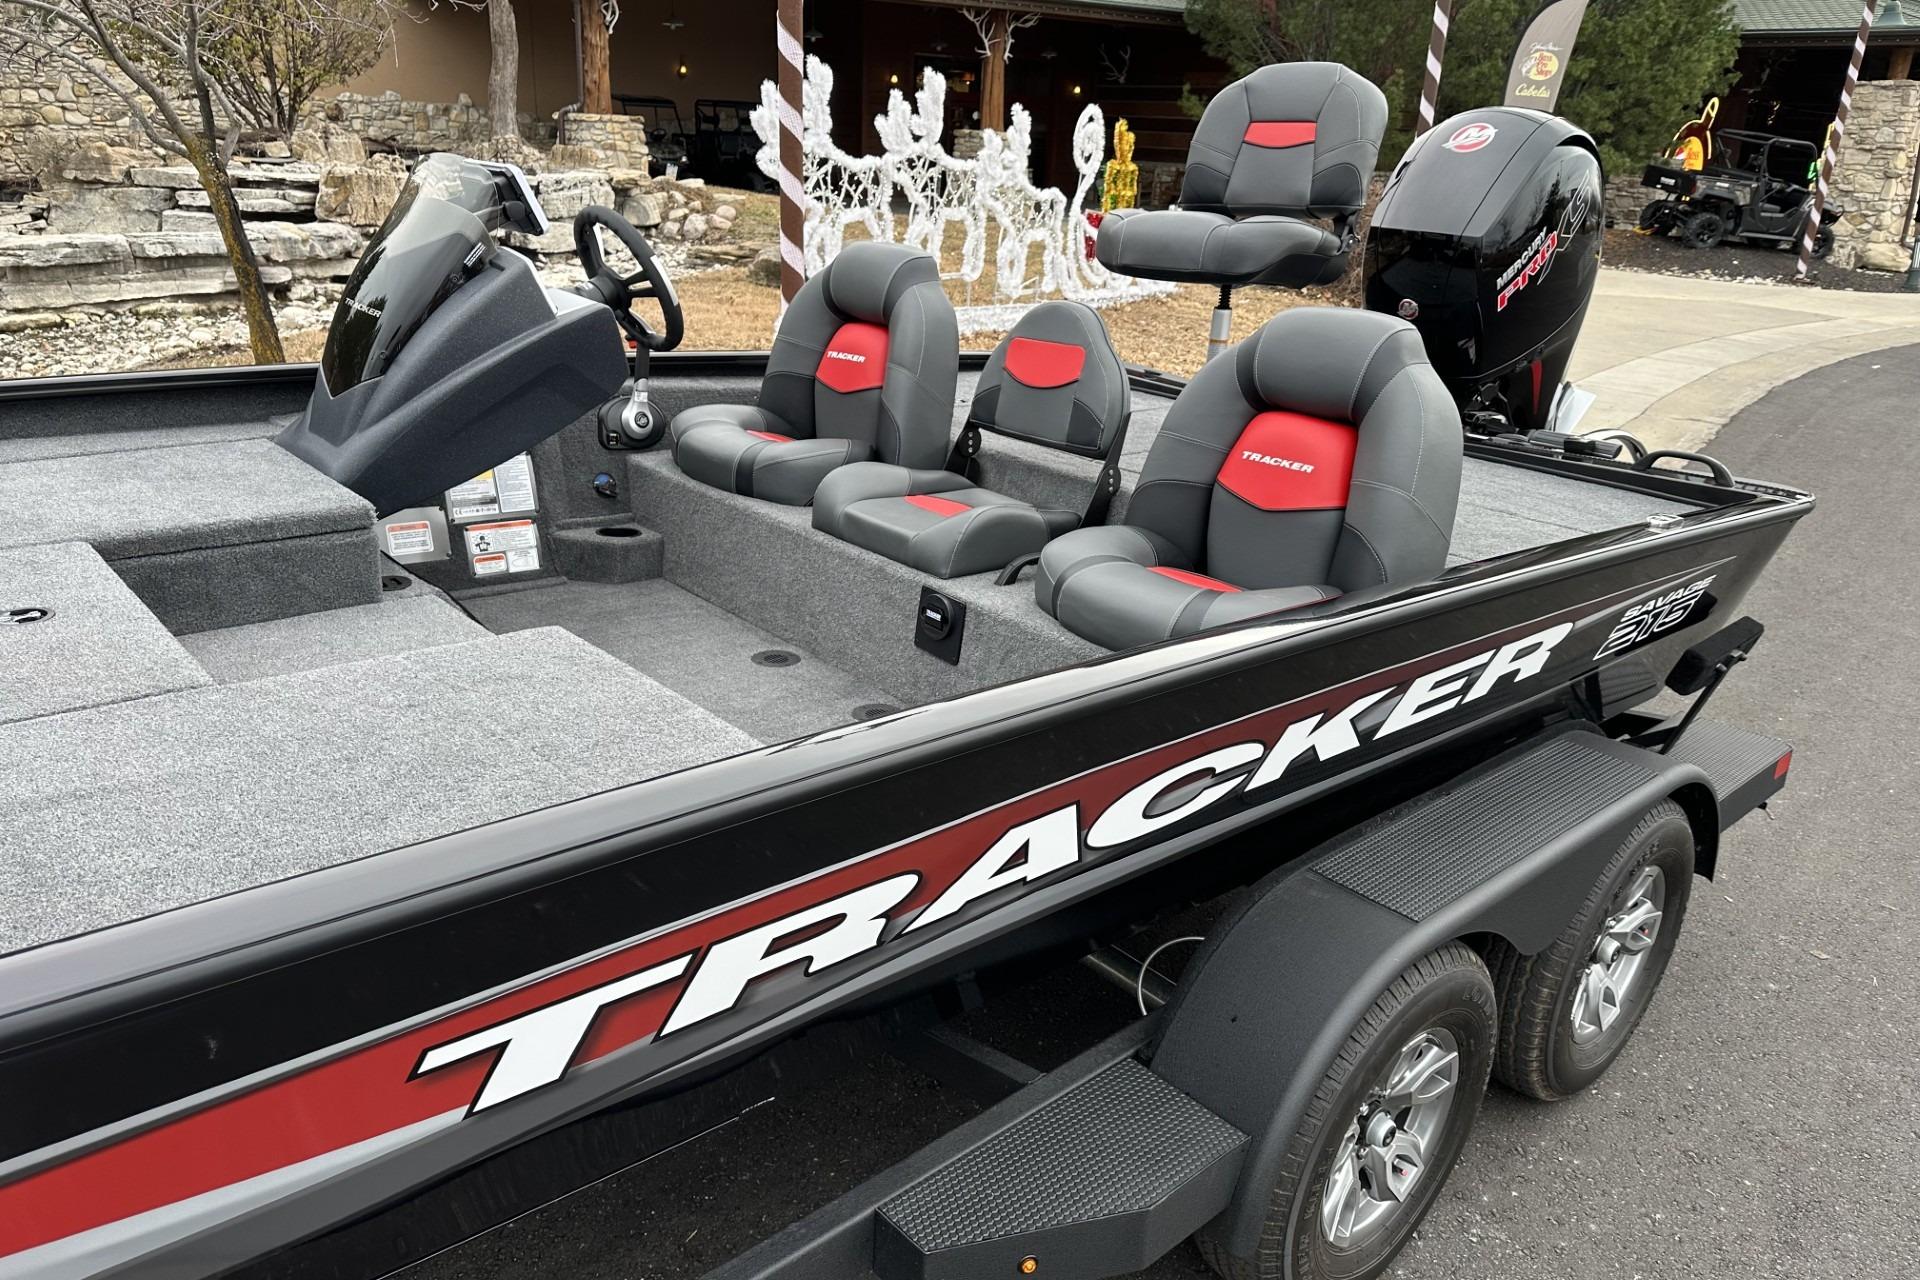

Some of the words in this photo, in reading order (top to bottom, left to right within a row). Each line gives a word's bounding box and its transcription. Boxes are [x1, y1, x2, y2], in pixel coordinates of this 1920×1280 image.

[1496, 226, 1547, 290] MERCURY
[1497, 230, 1558, 312] PRO
[344, 297, 382, 318] TRACKER
[827, 351, 866, 363] TRACKER
[1242, 450, 1315, 473] TRACKER
[1620, 574, 1718, 623] SAVAGE
[414, 621, 1574, 1113] TRACKER
